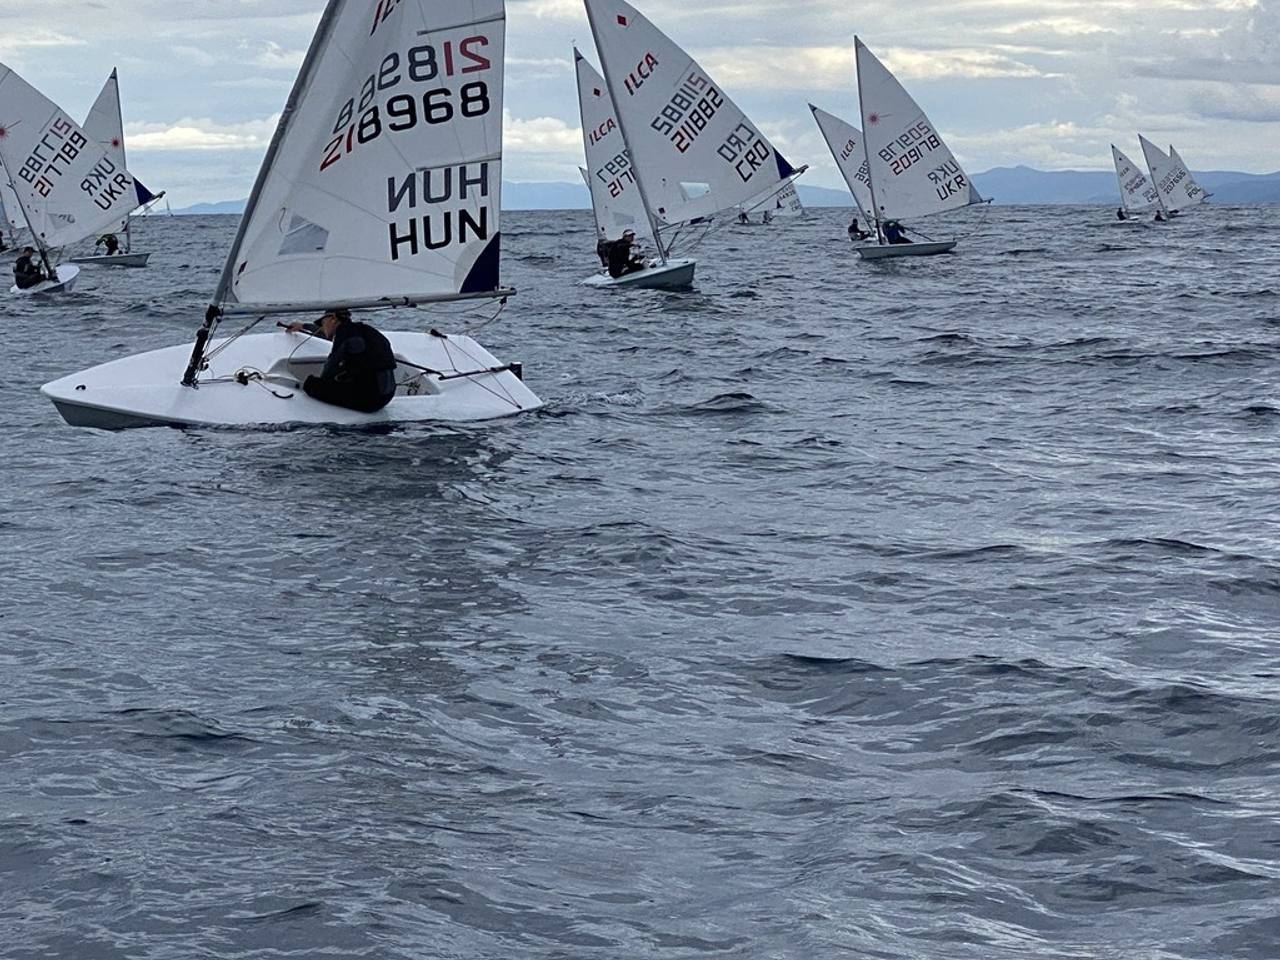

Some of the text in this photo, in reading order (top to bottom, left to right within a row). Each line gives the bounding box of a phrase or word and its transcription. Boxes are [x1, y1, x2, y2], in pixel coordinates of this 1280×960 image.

[624, 53, 658, 96] ILCA
[320, 81, 490, 171] 218968
[589, 118, 616, 146] ILCA
[670, 87, 723, 153] 211882
[34, 131, 87, 197] 217789
[735, 139, 770, 182] CRO
[840, 139, 856, 161] ILCA
[890, 134, 940, 175] 209178
[94, 173, 132, 210] UKR
[936, 174, 967, 201] UKR
[389, 206, 487, 260] HUN
